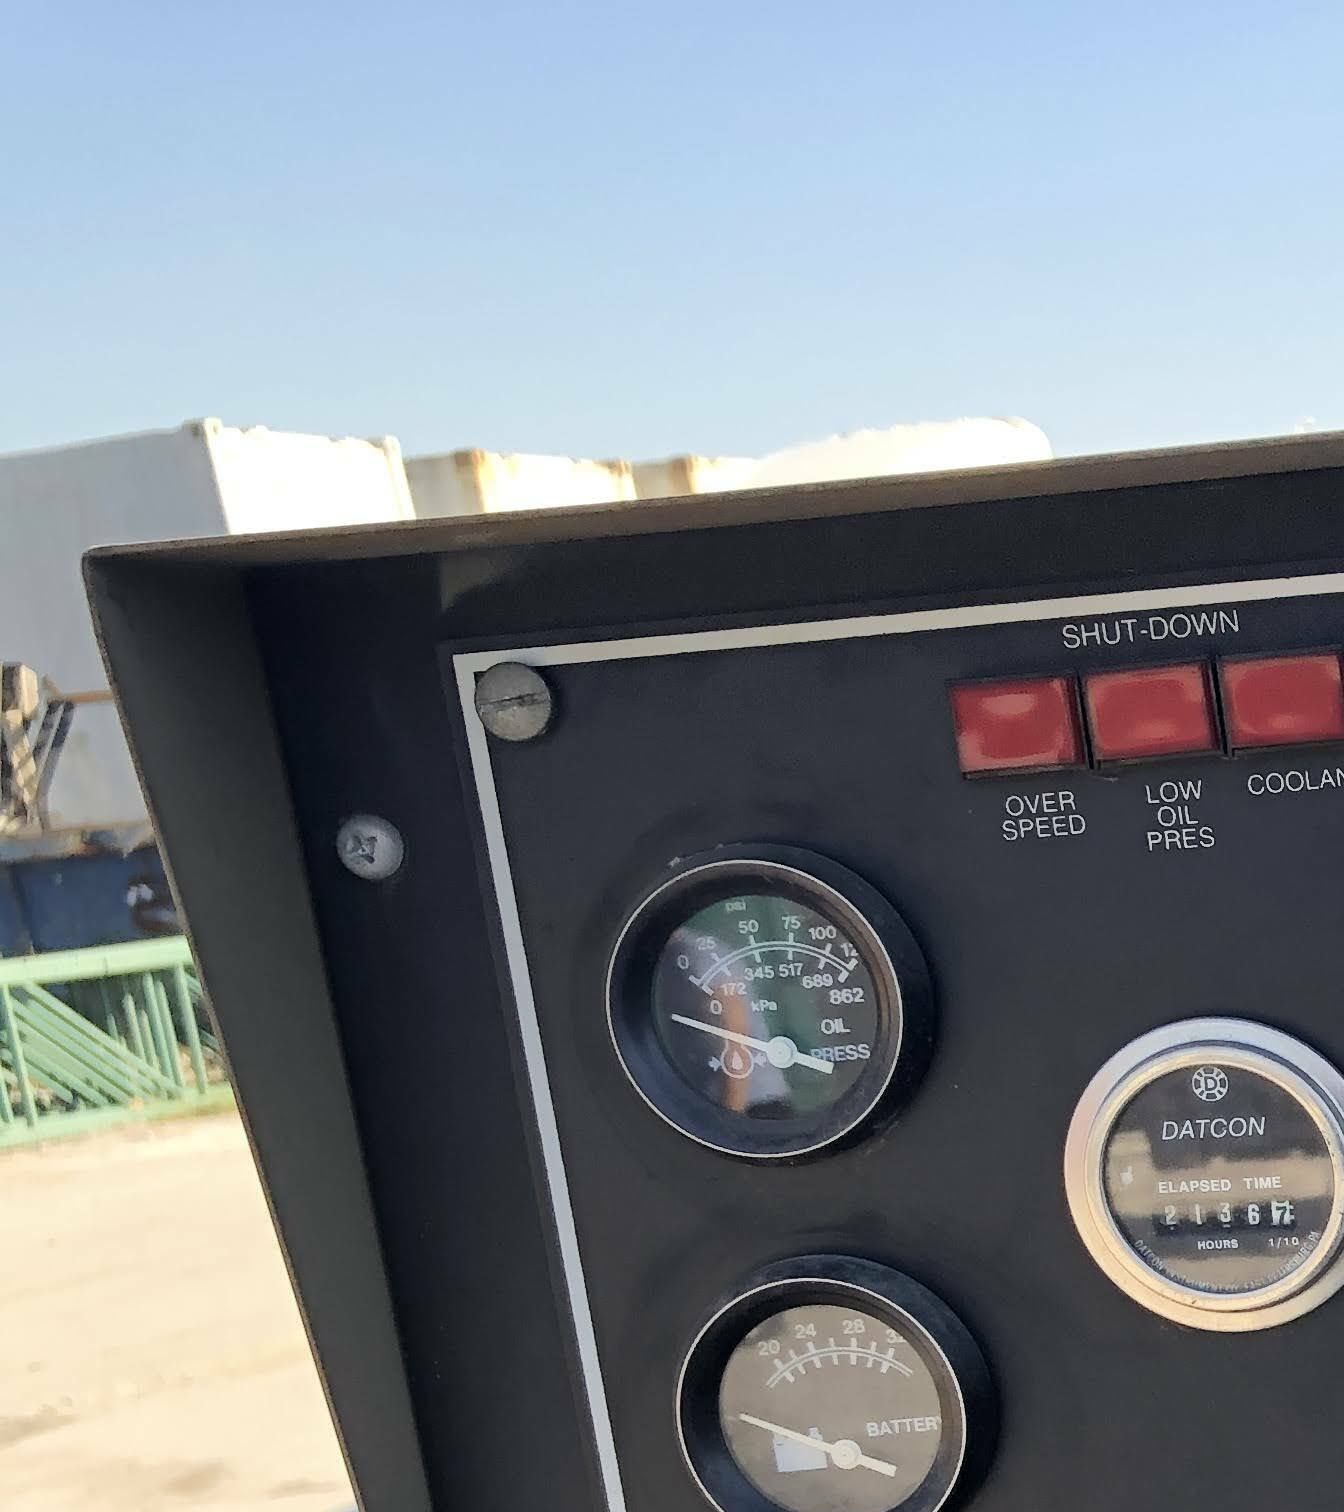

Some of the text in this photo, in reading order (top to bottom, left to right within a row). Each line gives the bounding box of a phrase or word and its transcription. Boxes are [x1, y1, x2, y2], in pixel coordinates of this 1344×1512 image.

[1062, 609, 1239, 649] SHUT-DOWN
[1145, 780, 1202, 804] LOW
[1005, 791, 1075, 816] OVER
[1157, 806, 1199, 828] OIL
[1002, 815, 1086, 841] SPEED
[1147, 826, 1215, 851] PRES
[738, 920, 758, 933] 50
[782, 916, 800, 929] 75
[809, 926, 836, 940] 100
[779, 963, 803, 977] 517
[802, 975, 833, 988] 689
[829, 989, 864, 1004] 862
[821, 1019, 850, 1034] OIL
[1162, 1117, 1266, 1141] DATCON
[1159, 1176, 1282, 1193] ELAPSED TIME
[1197, 1237, 1299, 1249] HOURS 1/10
[843, 1320, 865, 1334] 28
